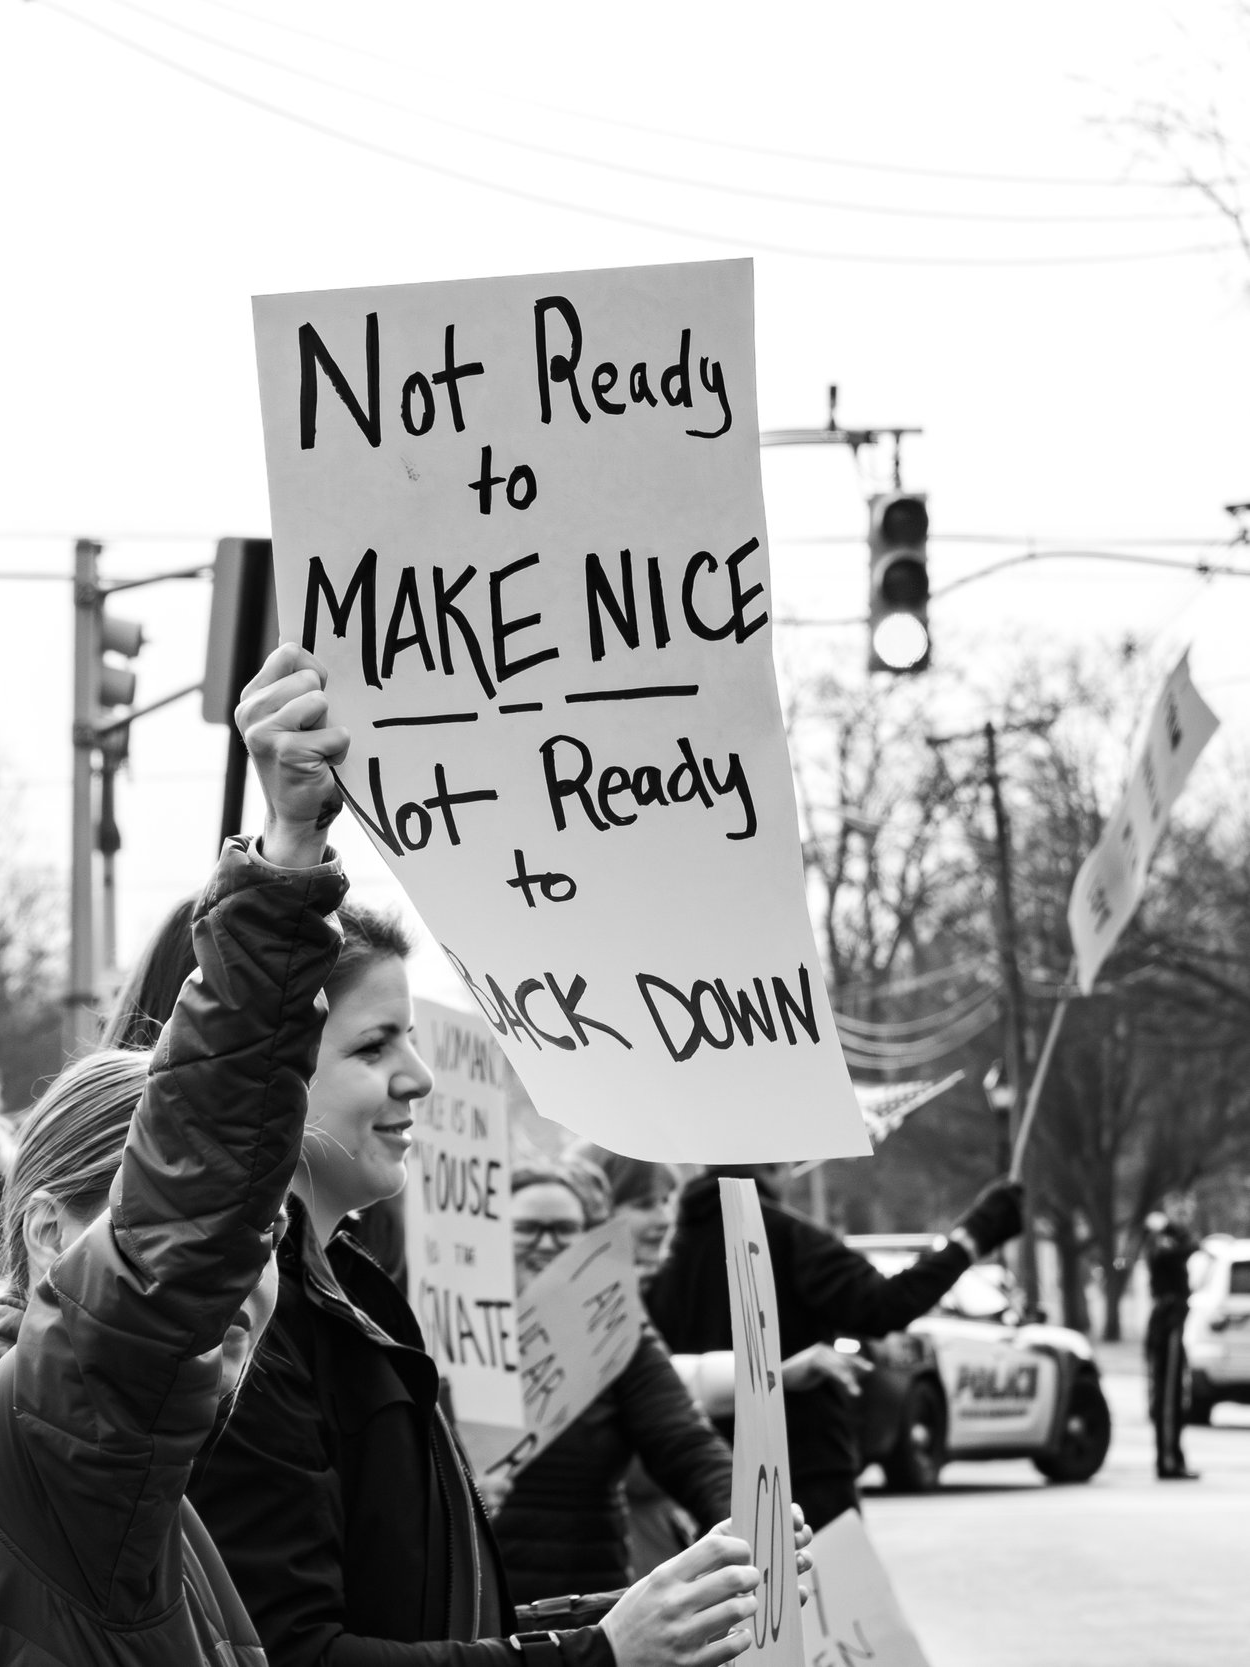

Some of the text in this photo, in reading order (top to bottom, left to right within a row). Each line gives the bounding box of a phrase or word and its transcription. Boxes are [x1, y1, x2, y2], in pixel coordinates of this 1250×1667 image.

[298, 296, 733, 450] Not Ready
[468, 445, 538, 515] to
[302, 537, 769, 699] MAKE NICE
[538, 735, 758, 840] Ready
[506, 849, 578, 908] to
[636, 963, 821, 1063] DOWN
[734, 1239, 777, 1398] WE
[956, 1364, 1040, 1401] POLICE
[752, 1463, 785, 1650] GO
